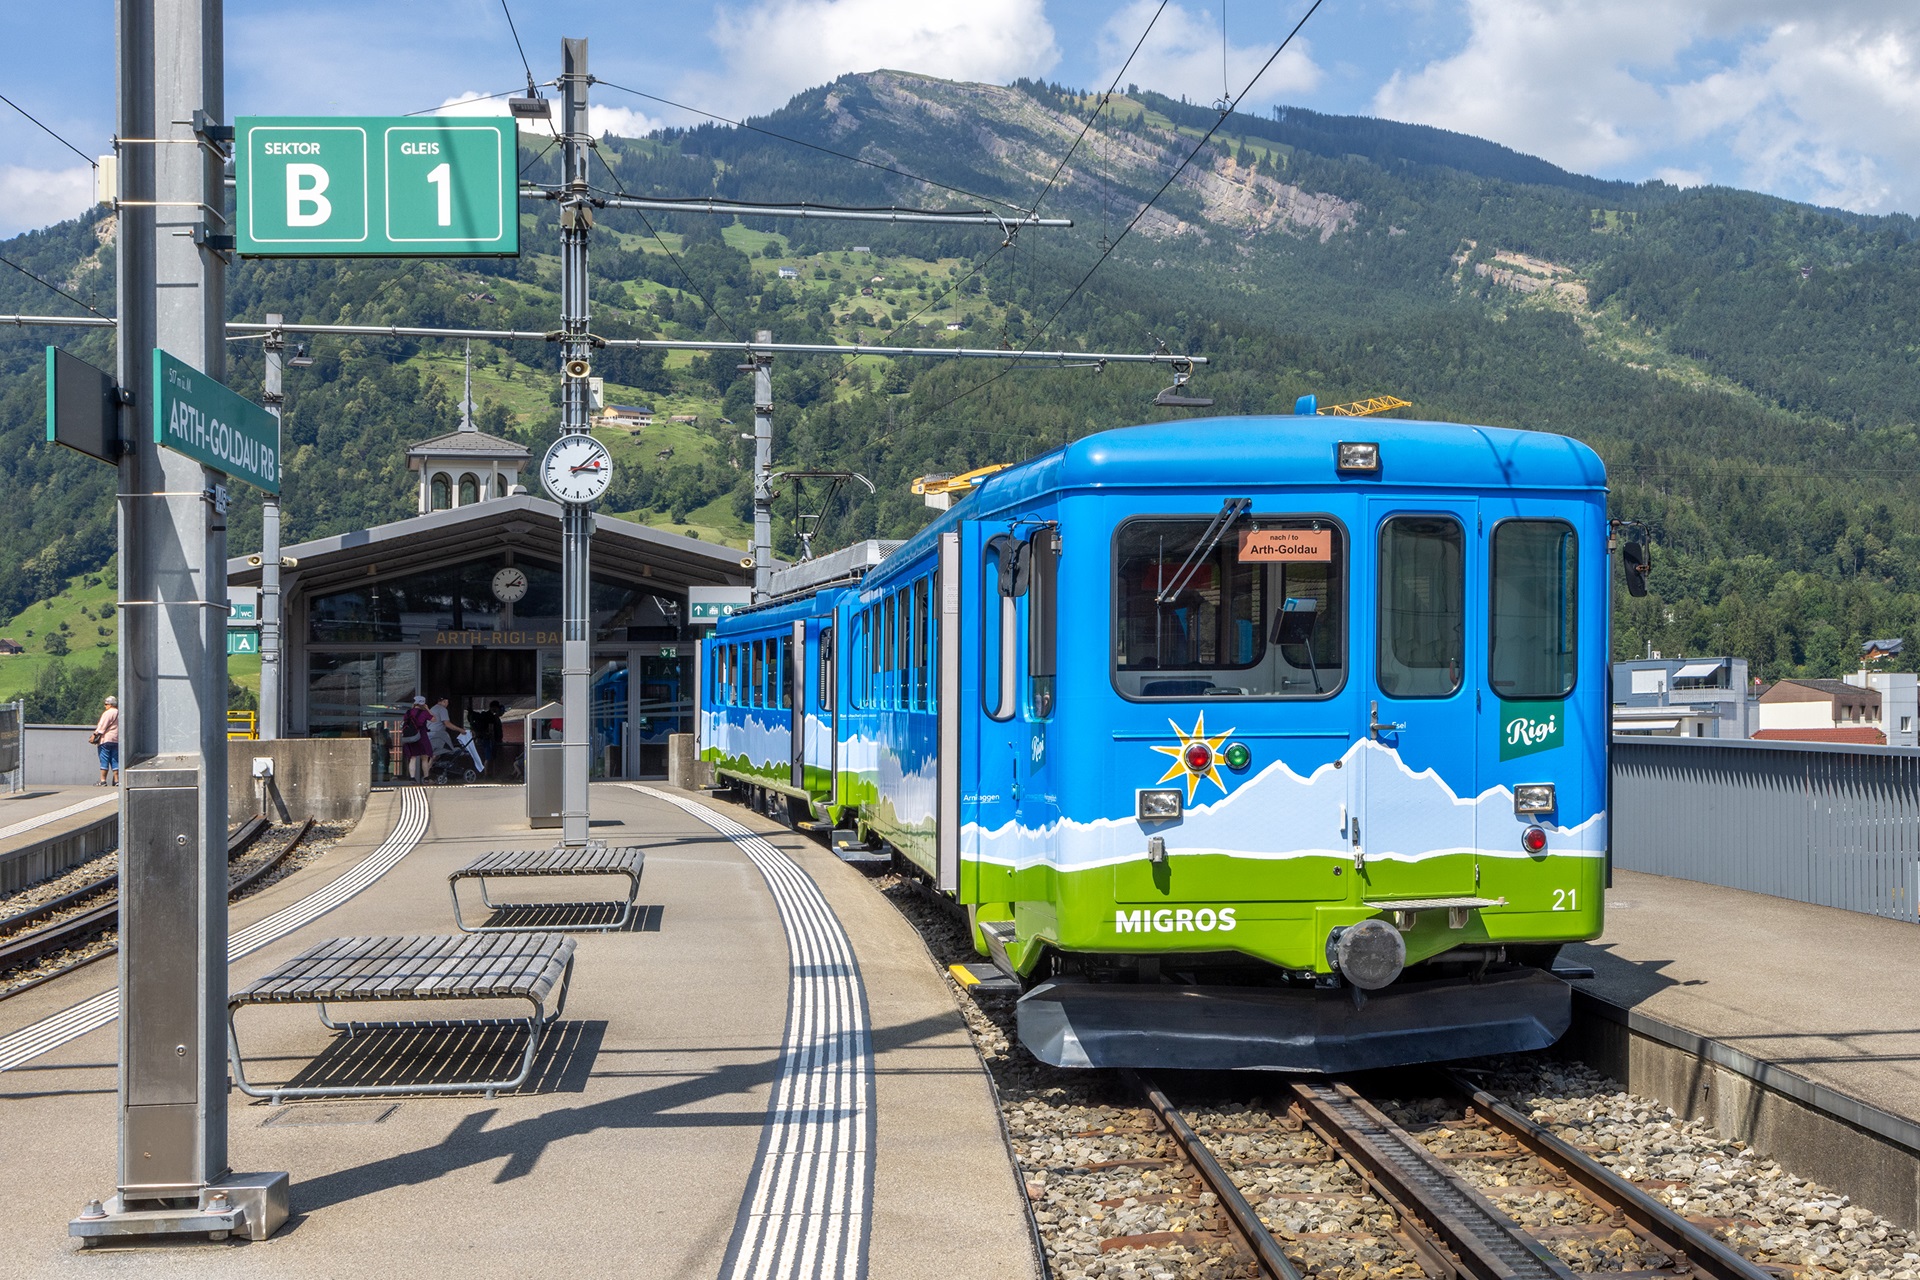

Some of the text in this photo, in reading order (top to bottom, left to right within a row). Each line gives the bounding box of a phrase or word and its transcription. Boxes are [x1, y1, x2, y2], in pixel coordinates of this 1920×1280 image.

[264, 142, 321, 155] SEKTOR
[400, 142, 440, 155] GLEIS
[286, 163, 332, 227] B
[426, 163, 451, 227] 1
[169, 397, 275, 482] ARTH-GOLDAU RB
[1250, 544, 1318, 555] Arth-Goldau
[238, 637, 251, 650] A
[435, 631, 564, 644] ARTH-RIGI-BA
[1506, 714, 1557, 746] Rigi
[1552, 888, 1576, 911] 21
[1115, 907, 1237, 933] MIGROS
